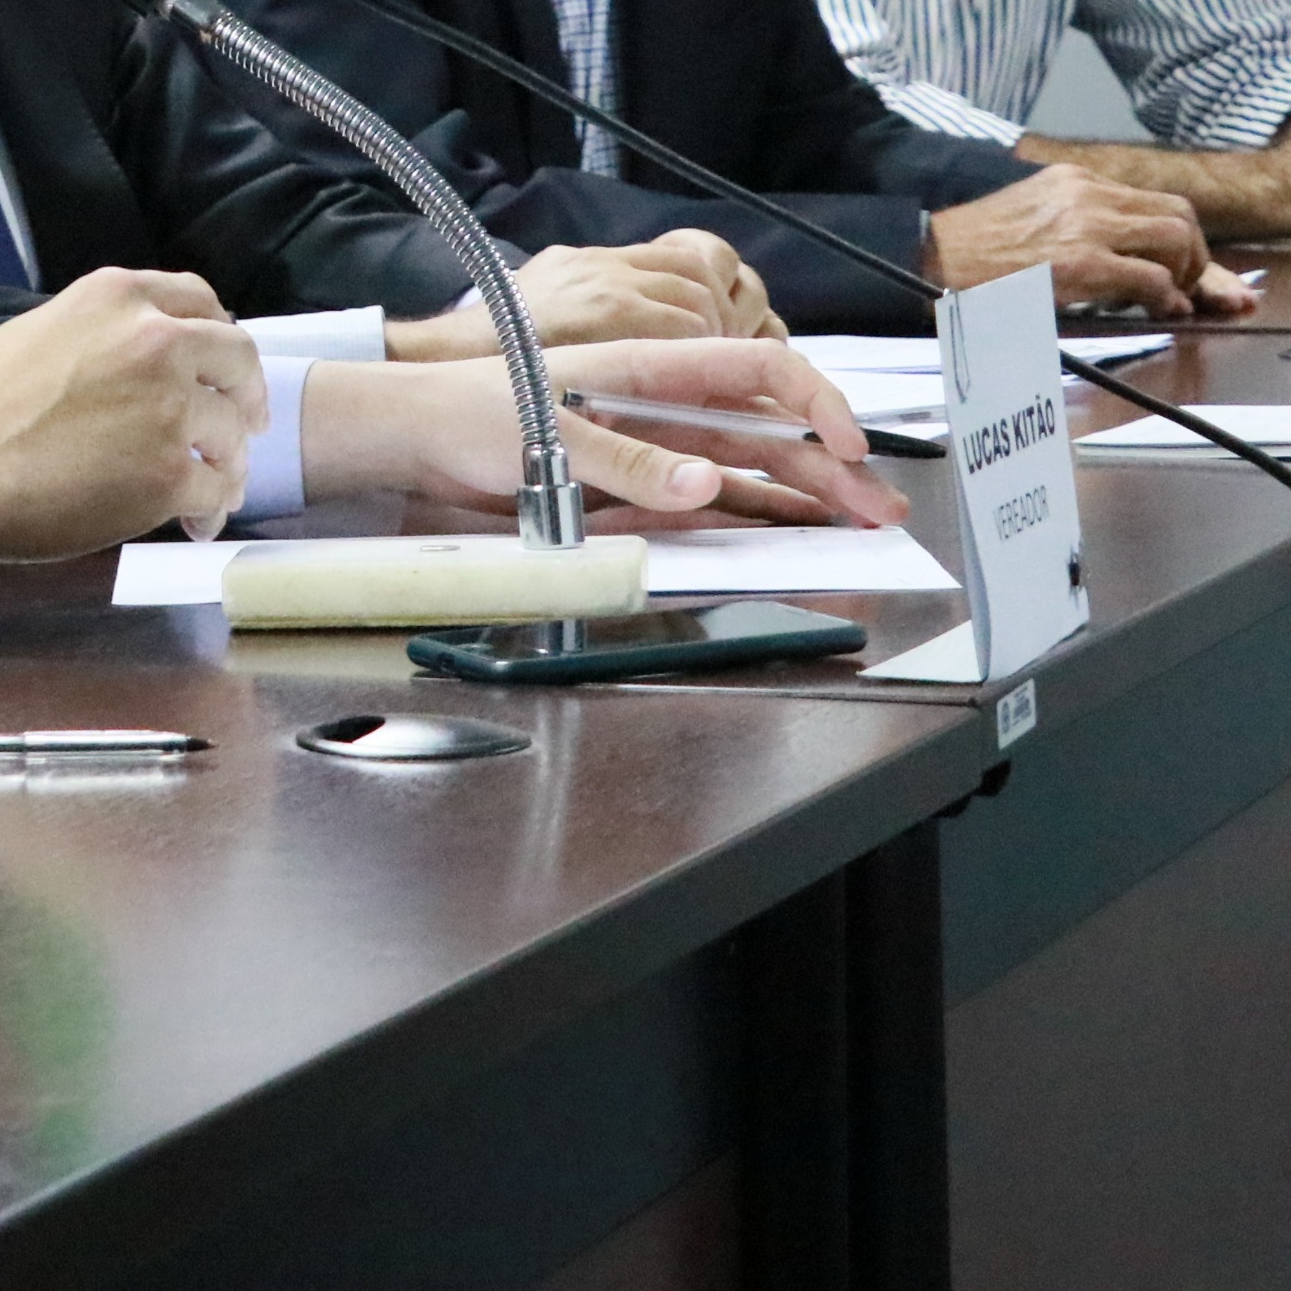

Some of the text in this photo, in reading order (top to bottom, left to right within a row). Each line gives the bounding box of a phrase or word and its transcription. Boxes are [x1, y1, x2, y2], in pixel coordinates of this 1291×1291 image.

[963, 393, 1055, 474] LUCAS KITÃO
[993, 484, 1050, 541] VEREADOR
